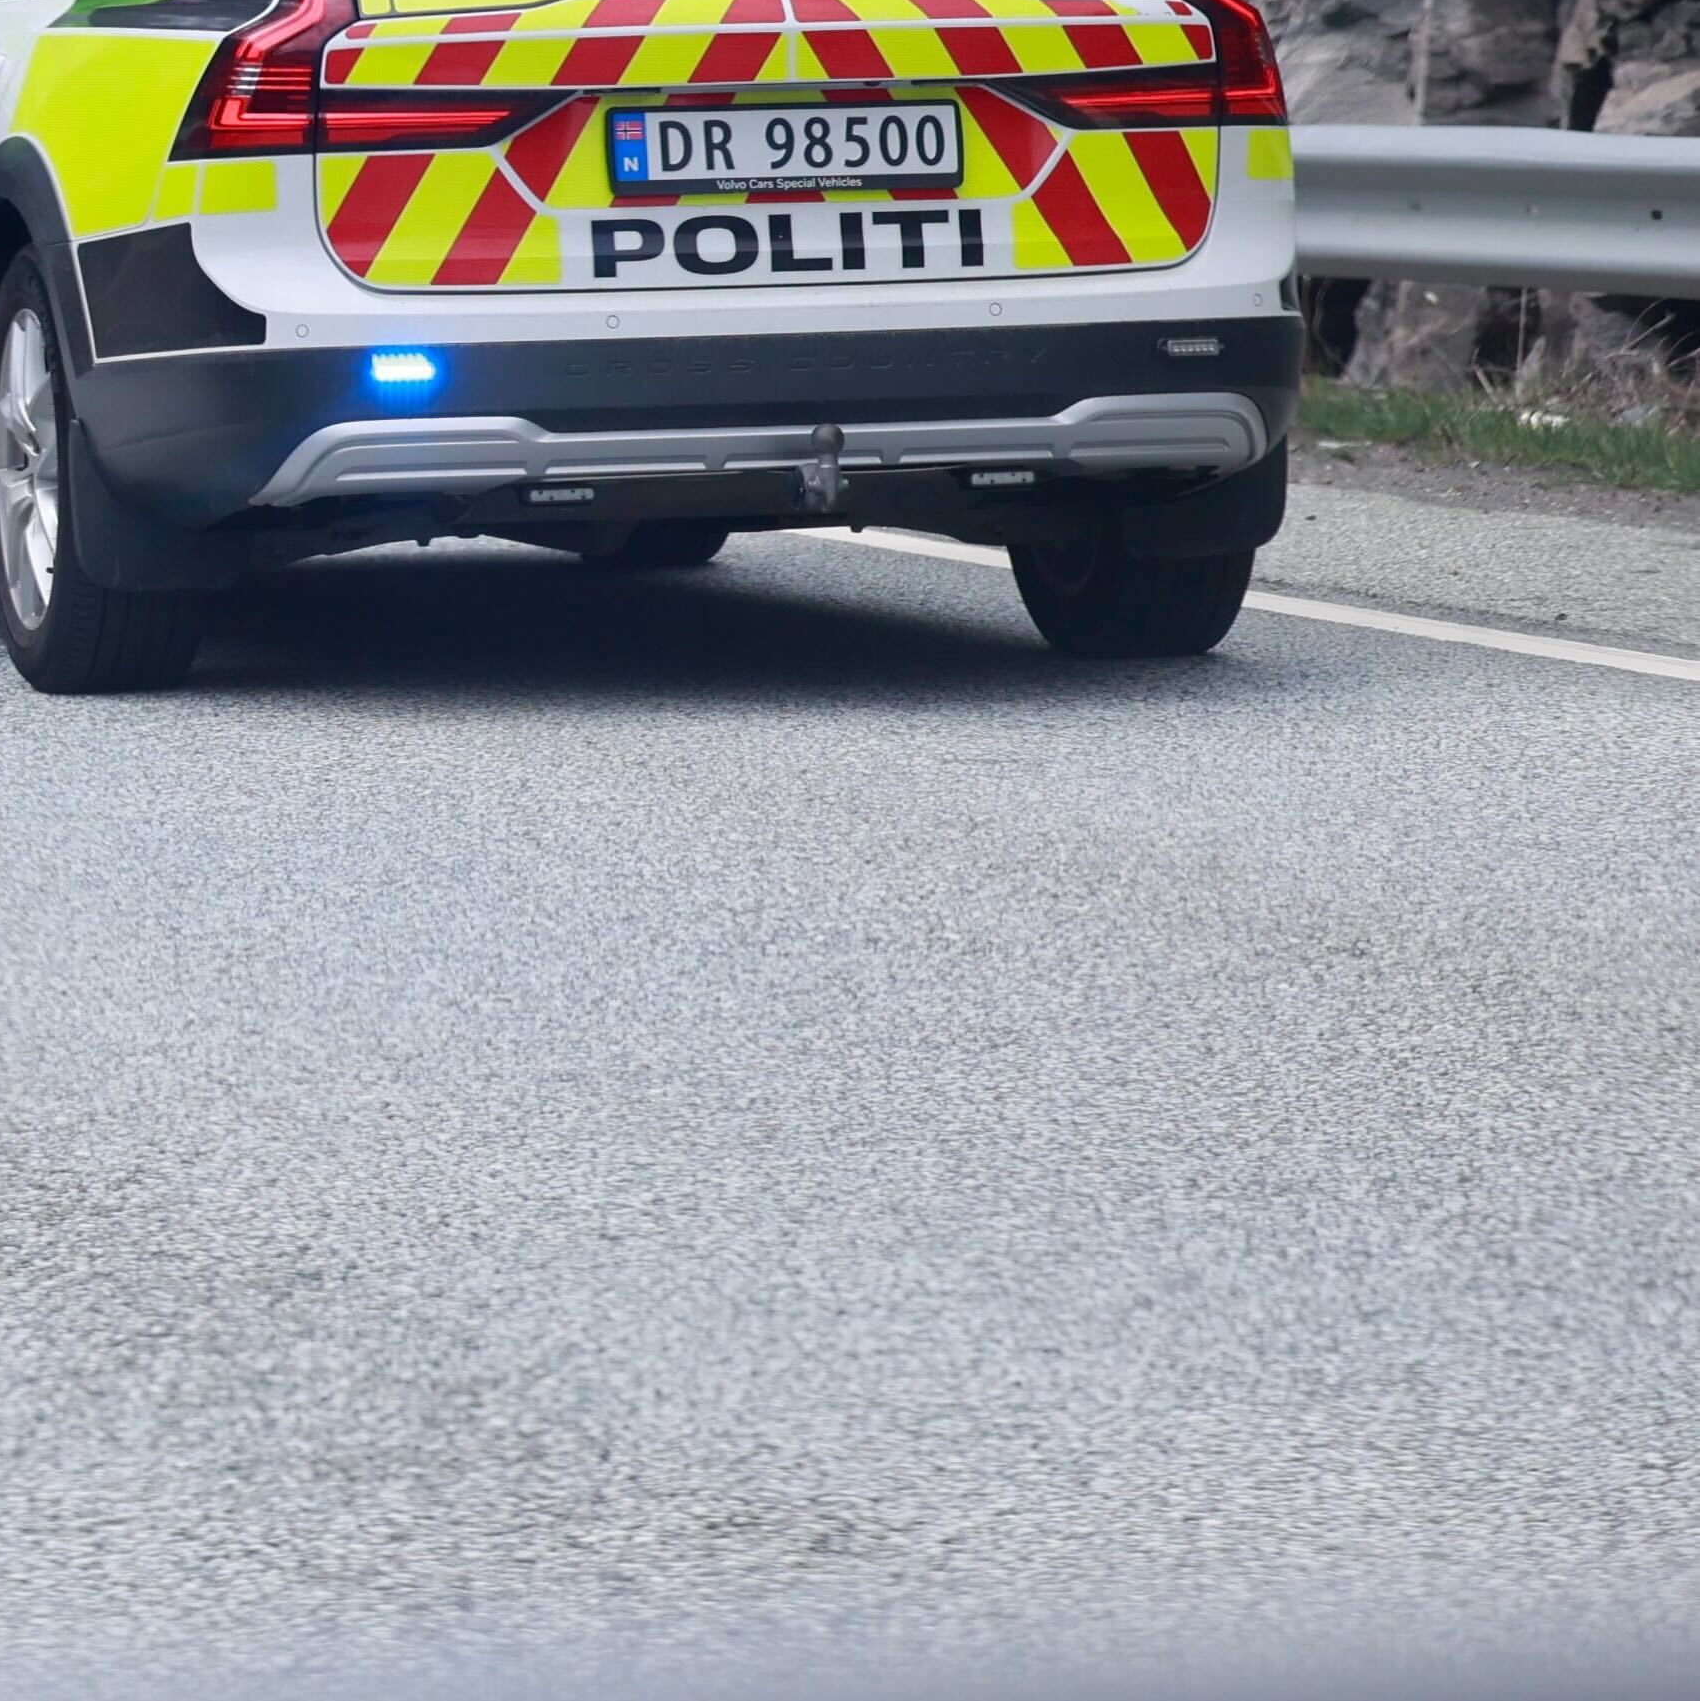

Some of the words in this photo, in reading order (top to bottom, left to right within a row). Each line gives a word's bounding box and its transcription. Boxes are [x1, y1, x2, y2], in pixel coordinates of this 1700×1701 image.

[659, 119, 735, 172] DR
[765, 115, 945, 169] 98500
[623, 157, 639, 172] N
[716, 180, 746, 190] Volvo
[749, 179, 774, 189] Cars
[776, 178, 816, 190] Special
[818, 176, 862, 188] Vehicles
[591, 209, 984, 278] POLITI
